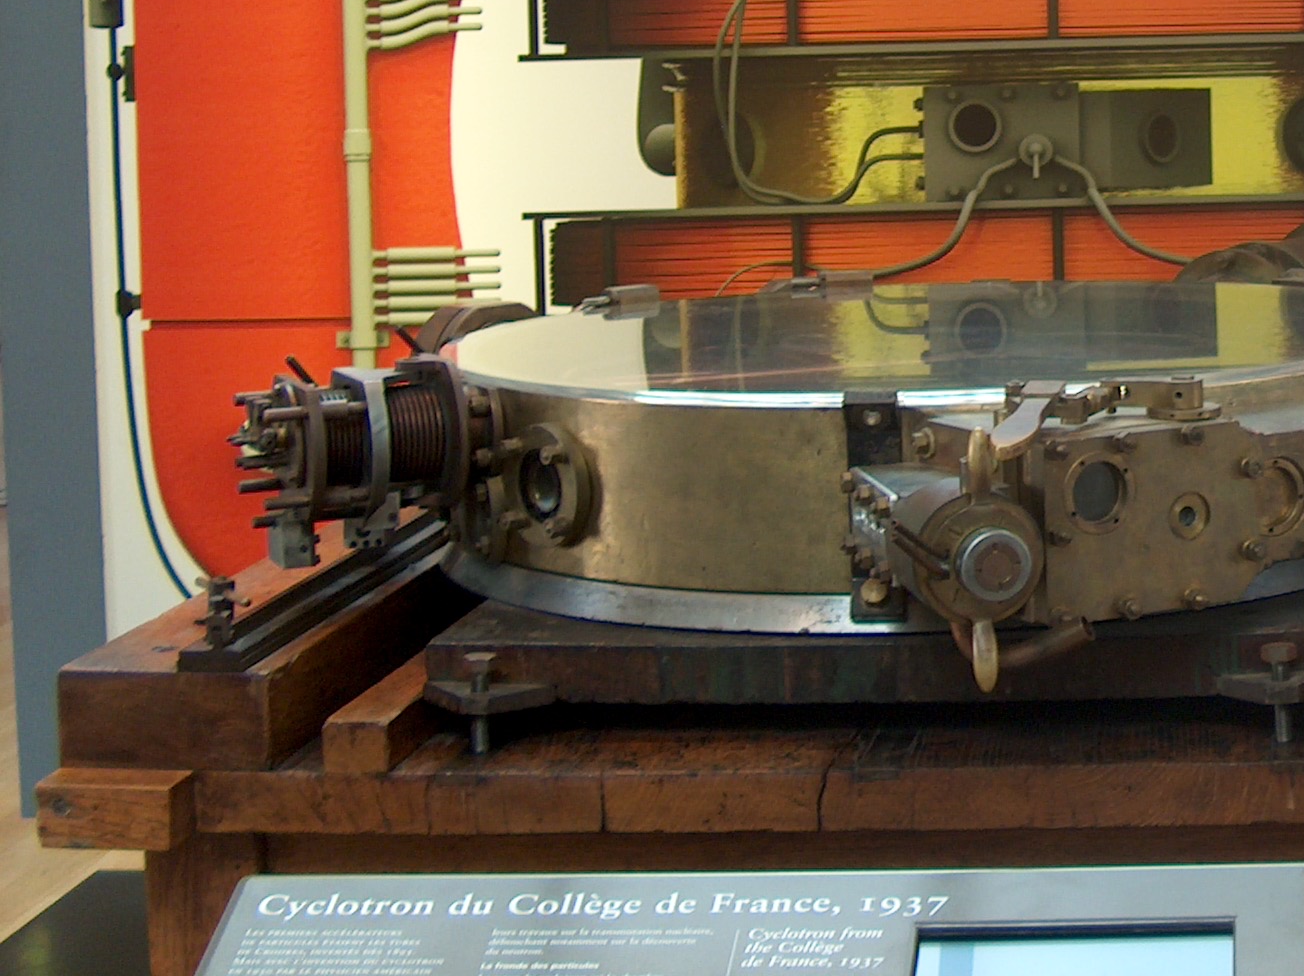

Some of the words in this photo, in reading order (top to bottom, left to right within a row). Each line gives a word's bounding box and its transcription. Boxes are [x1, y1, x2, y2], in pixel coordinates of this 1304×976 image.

[258, 892, 435, 922] Cyclotron
[449, 892, 494, 916] du
[508, 892, 642, 920] Collège
[655, 892, 698, 915] de
[709, 892, 841, 917] France,
[859, 895, 950, 917] 1937
[748, 927, 836, 941] Cyclotron
[836, 926, 884, 941] from
[744, 940, 772, 954] the
[778, 940, 844, 955] Collège
[531, 961, 549, 970] des
[550, 961, 600, 972] particules
[741, 955, 762, 968] de
[768, 956, 833, 969] France,
[840, 956, 885, 970] 1937
